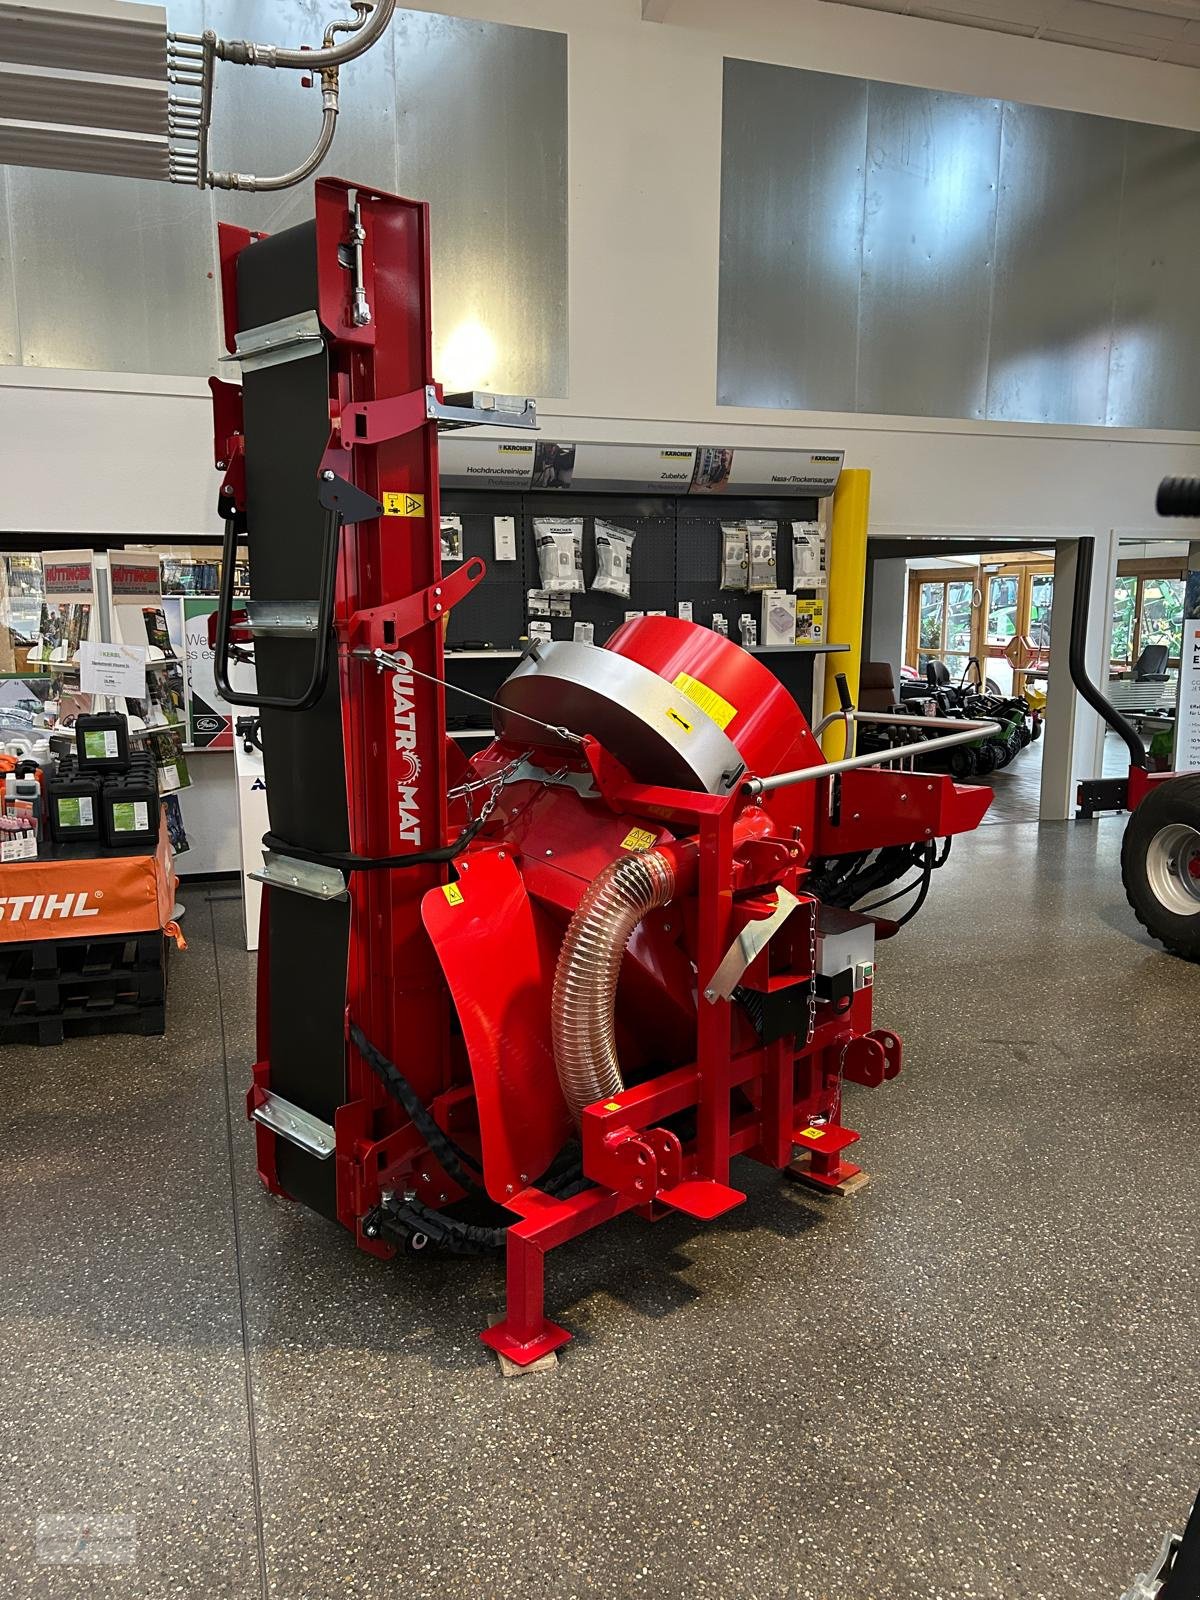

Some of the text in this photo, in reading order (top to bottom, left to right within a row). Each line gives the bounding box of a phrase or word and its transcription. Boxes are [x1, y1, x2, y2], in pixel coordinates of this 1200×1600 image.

[503, 444, 533, 452] KÄRCHER
[466, 466, 531, 476] Hochdruckreiniger
[660, 471, 688, 480] Zubehör
